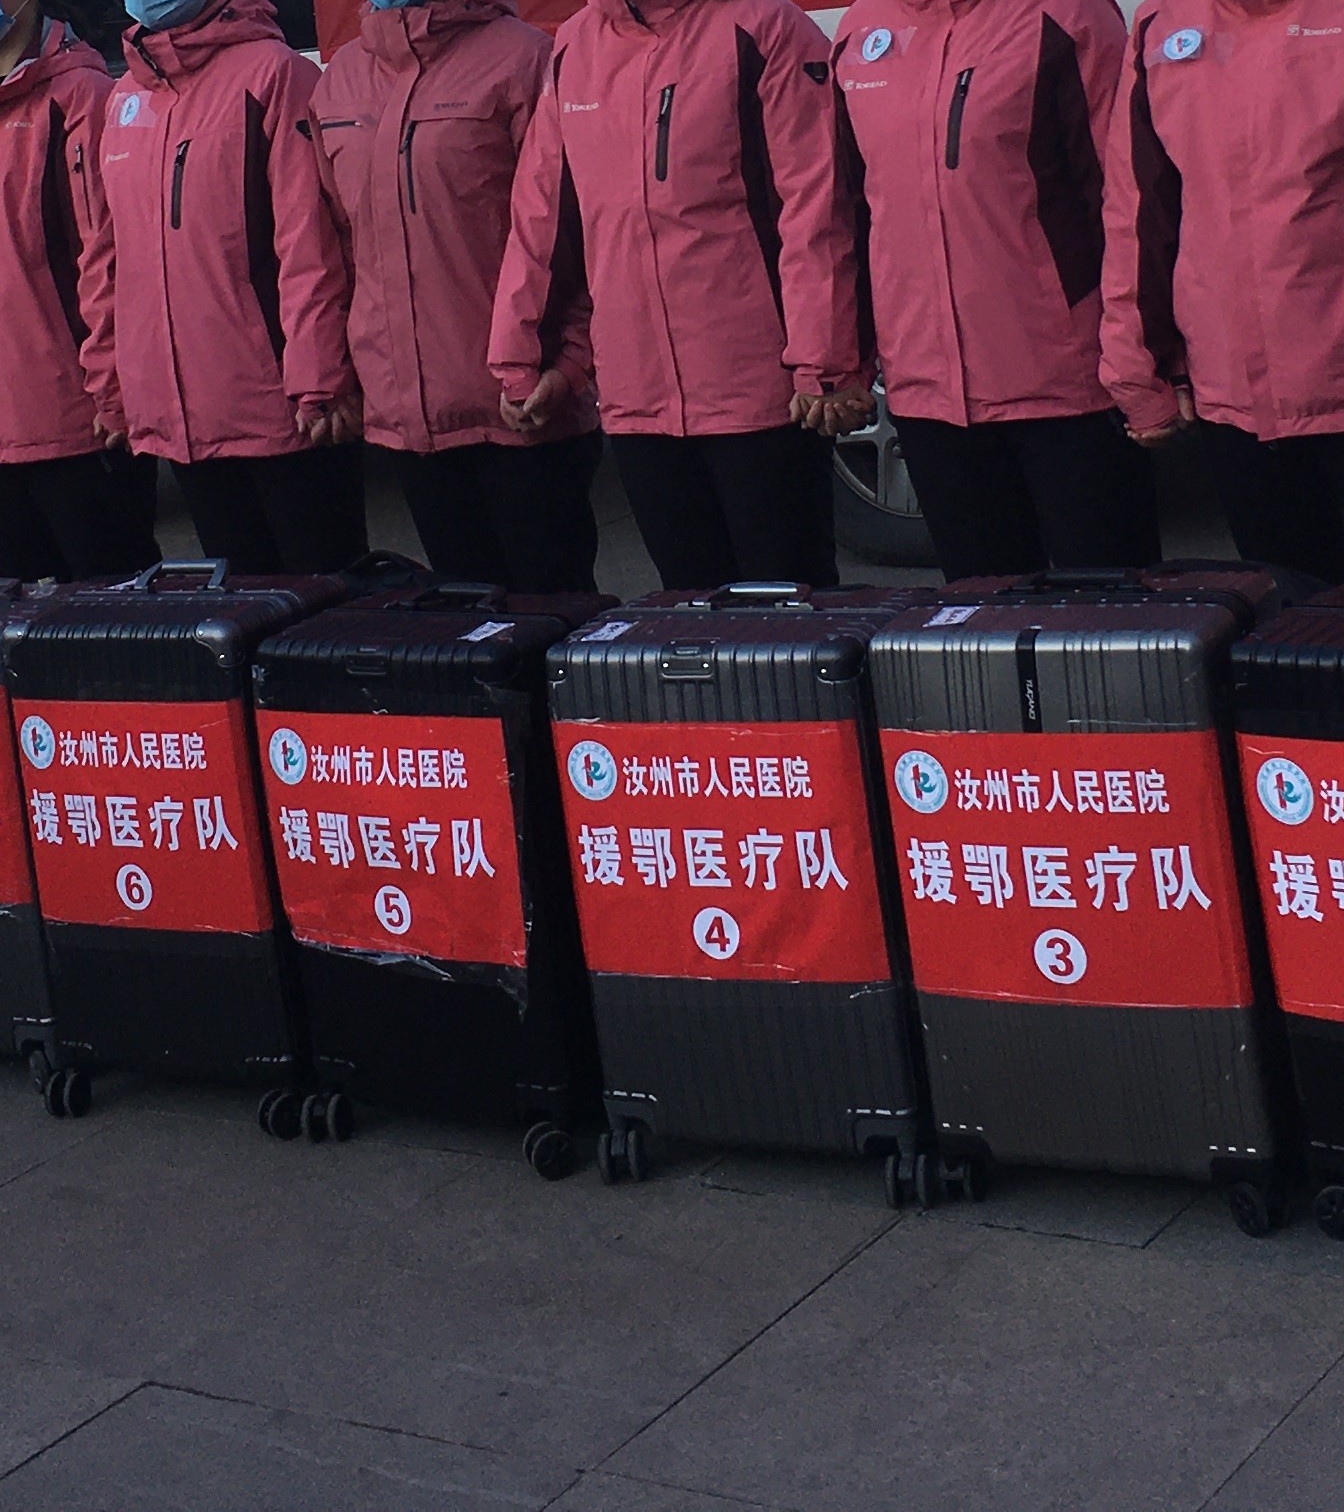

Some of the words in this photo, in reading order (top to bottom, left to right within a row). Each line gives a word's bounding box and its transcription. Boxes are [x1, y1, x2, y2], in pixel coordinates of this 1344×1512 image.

[58, 730, 207, 770] 汝州市人民医院
[310, 744, 468, 789] 汝州市人民医院
[622, 755, 813, 799] 汝州市人民医院
[954, 768, 1170, 814] 汝州市人民医院
[30, 788, 239, 852] 援鄂医疗队
[279, 806, 496, 878] 援鄂医疗队
[577, 824, 849, 891] 援鄂医疗队
[906, 837, 1212, 912] 援鄂医疗队
